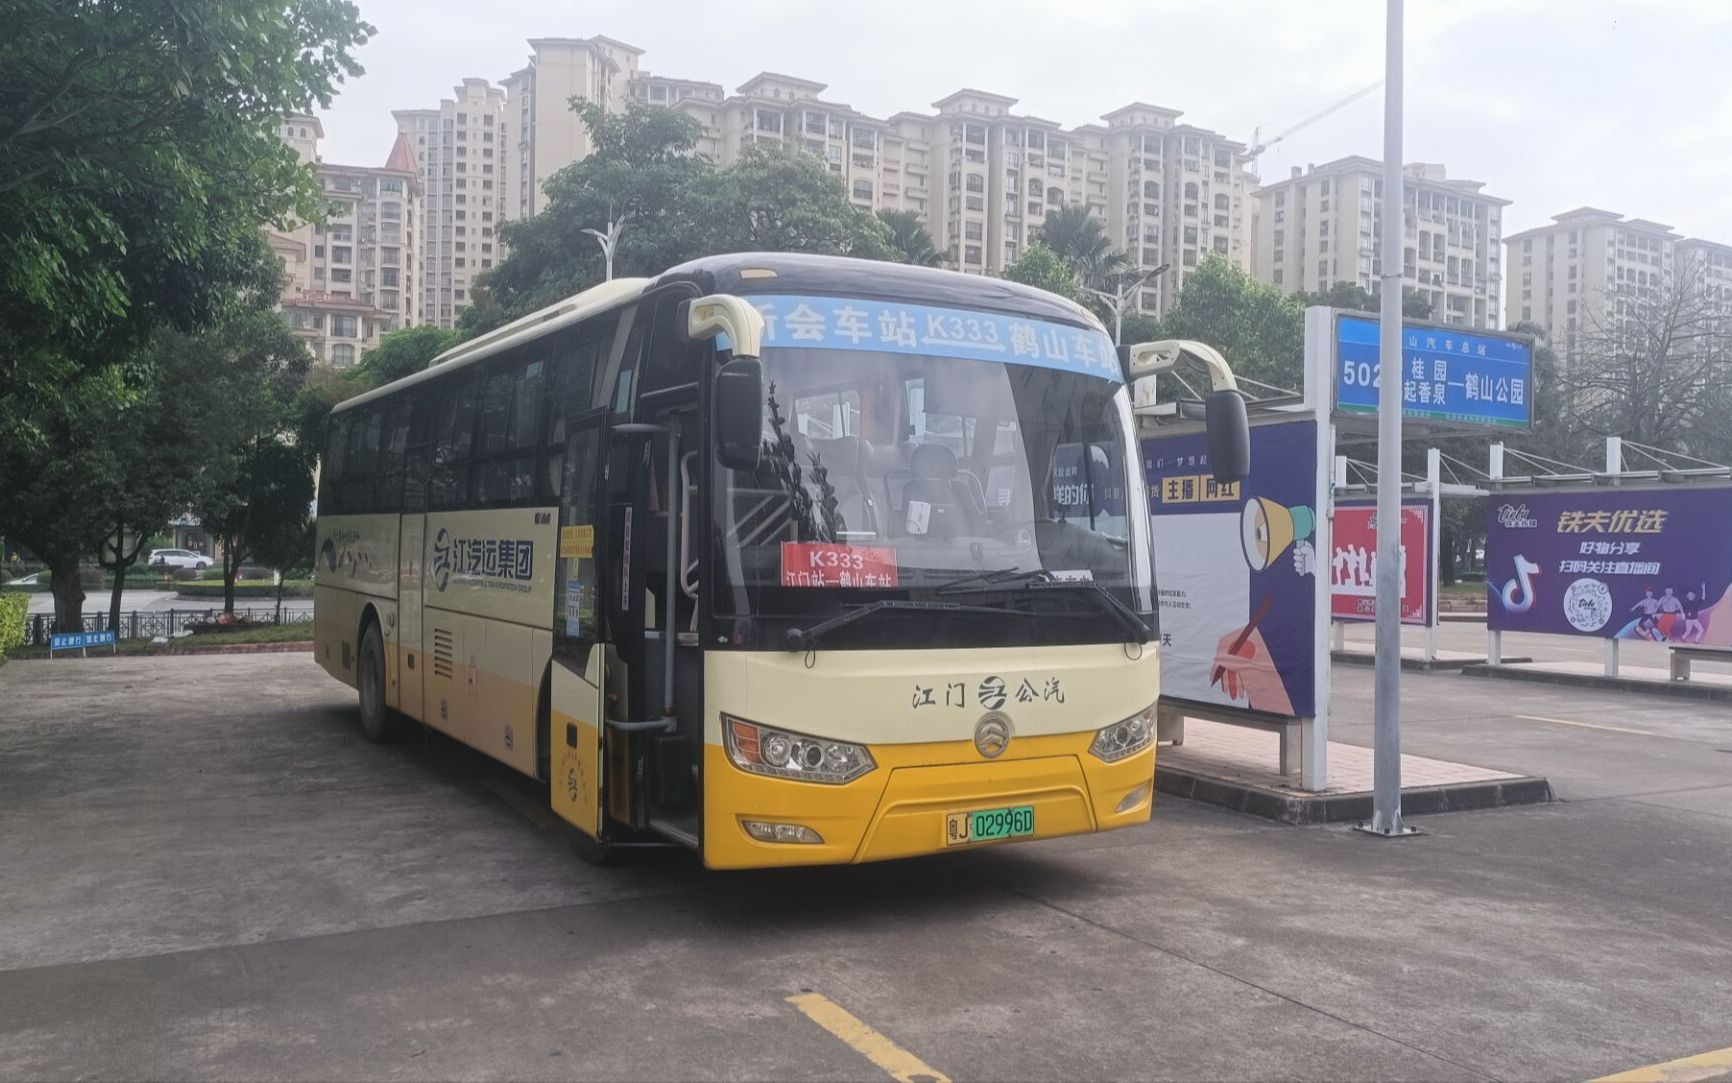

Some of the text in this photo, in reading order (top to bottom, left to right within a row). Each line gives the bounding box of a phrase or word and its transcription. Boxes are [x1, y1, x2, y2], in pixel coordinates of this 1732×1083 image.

[927, 317, 999, 342] K333
[1411, 356, 1447, 381] 桂园
[1167, 479, 1194, 500] 主播
[1556, 509, 1670, 533] 铁夫优选
[452, 539, 534, 581] 江汽运集团
[809, 550, 864, 569] K333
[1579, 541, 1641, 555] 好物分享
[1559, 560, 1662, 575] 扫码关注直播间
[912, 676, 1066, 709] 江门 公汽
